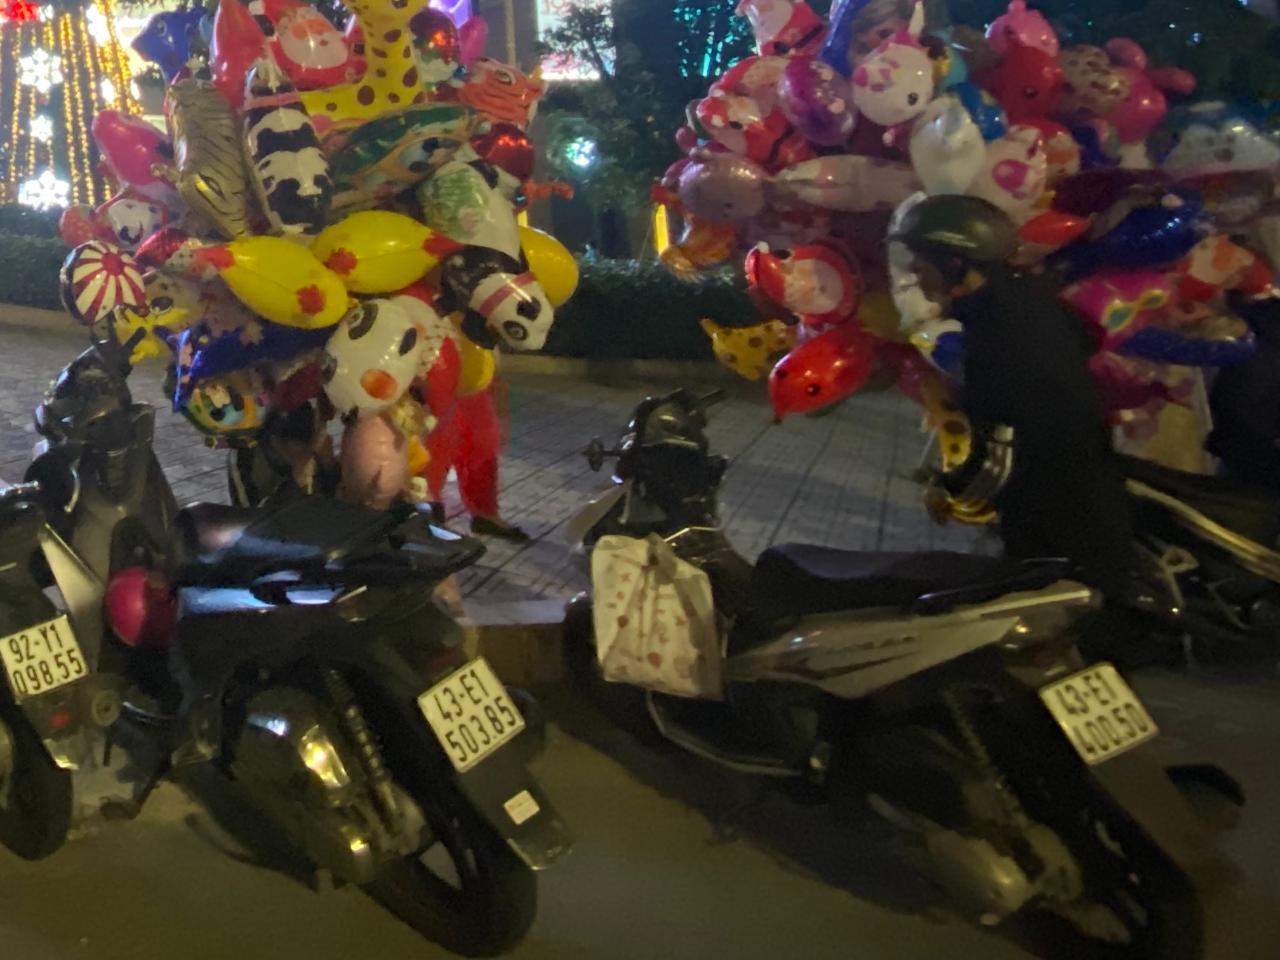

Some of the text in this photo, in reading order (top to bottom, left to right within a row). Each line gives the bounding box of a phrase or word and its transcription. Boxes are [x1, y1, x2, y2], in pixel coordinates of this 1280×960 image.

[8, 623, 63, 663] 92-Y1
[433, 669, 489, 722] 43-E1
[445, 696, 516, 762] 503.85
